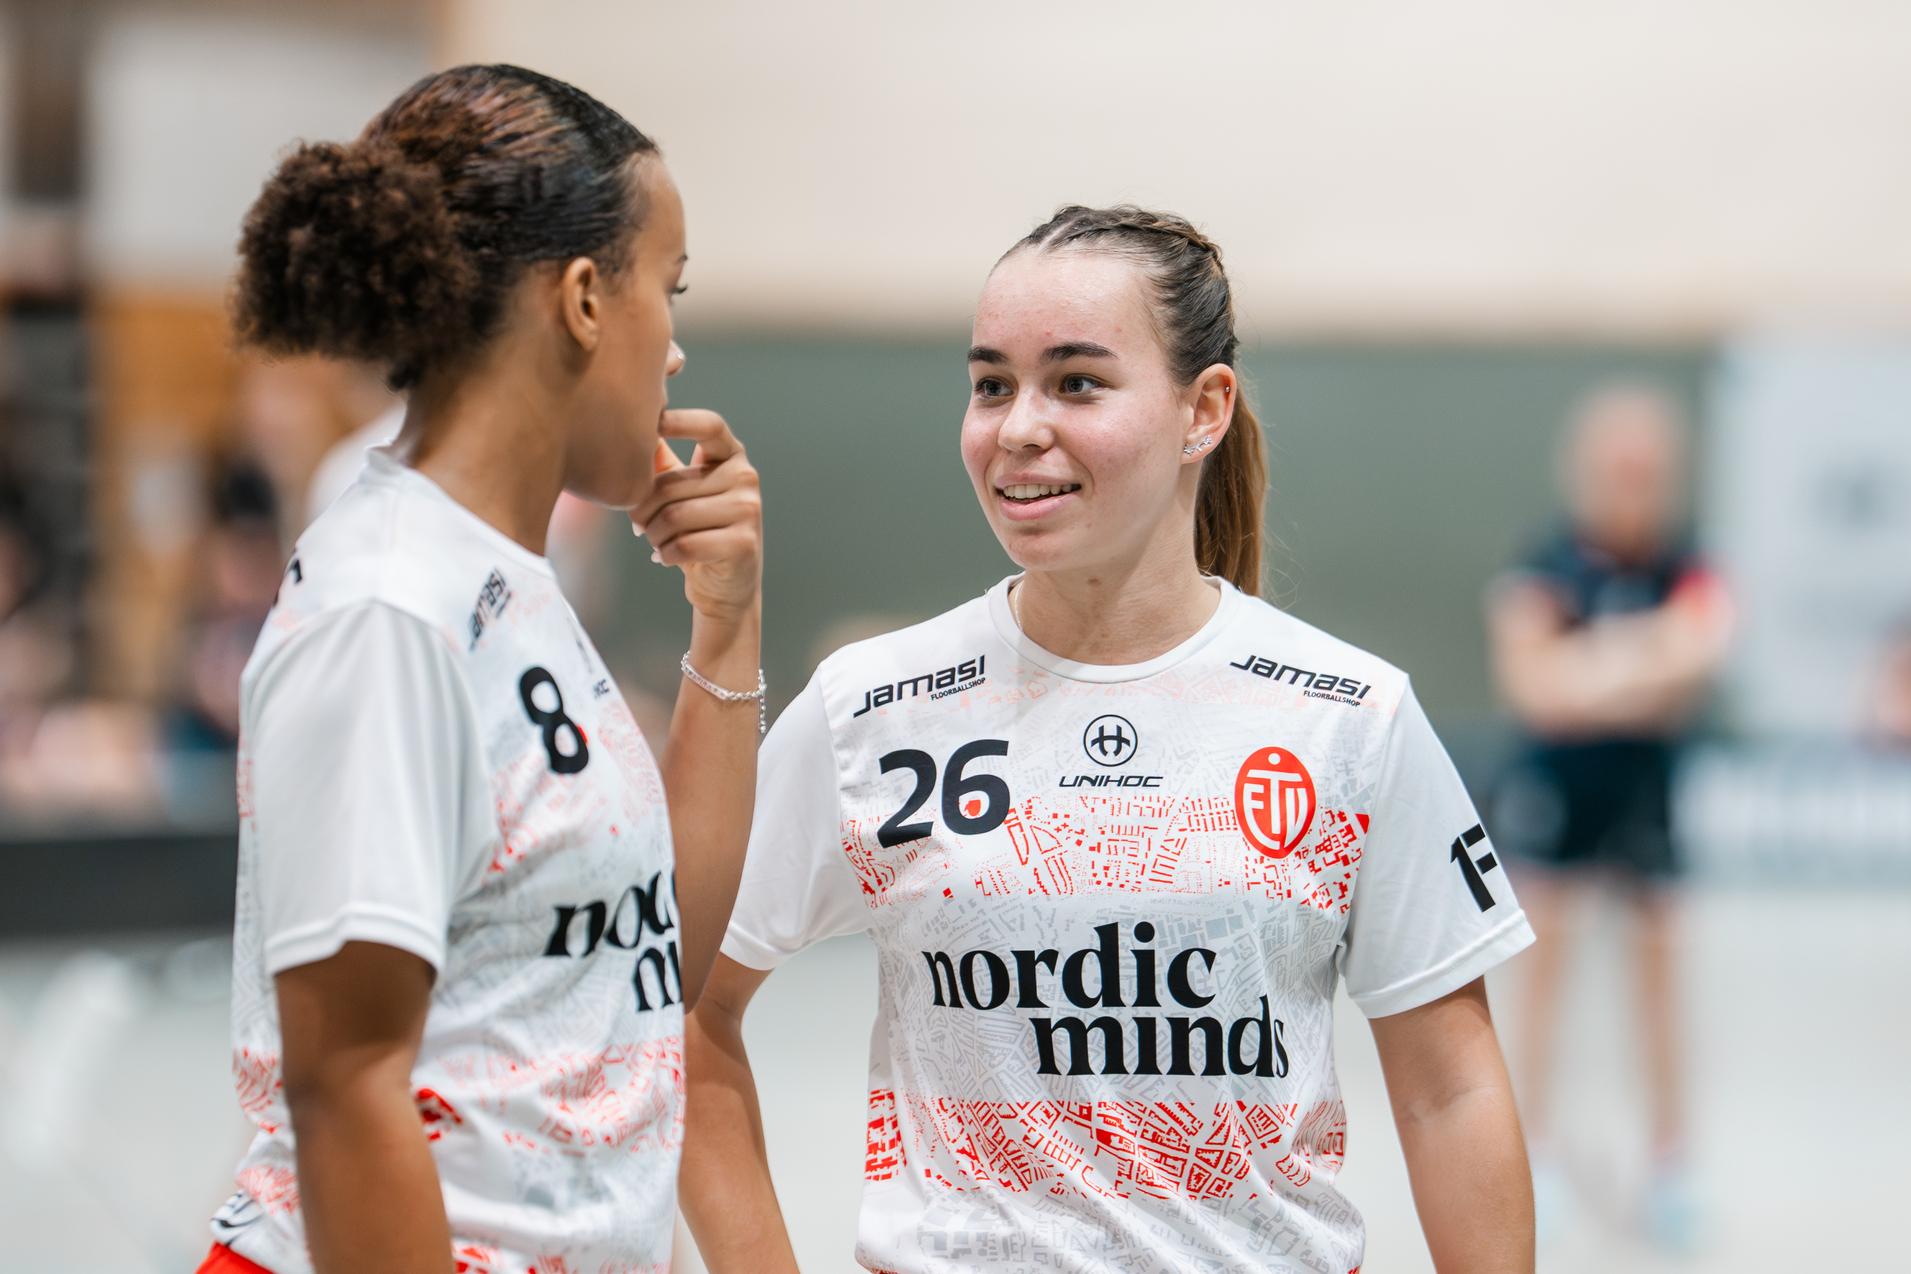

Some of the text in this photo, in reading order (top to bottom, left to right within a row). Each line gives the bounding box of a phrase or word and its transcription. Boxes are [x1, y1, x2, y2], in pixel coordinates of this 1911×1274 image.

[518, 665, 590, 775] 8
[930, 677, 986, 701] FLOORBALLSHOP
[1303, 690, 1361, 708] FLOORBALLSHOP
[876, 738, 1011, 849] 26
[1058, 775, 1164, 788] UNIHOC
[921, 920, 1218, 1011] nordic
[1028, 994, 1290, 1078] minds
